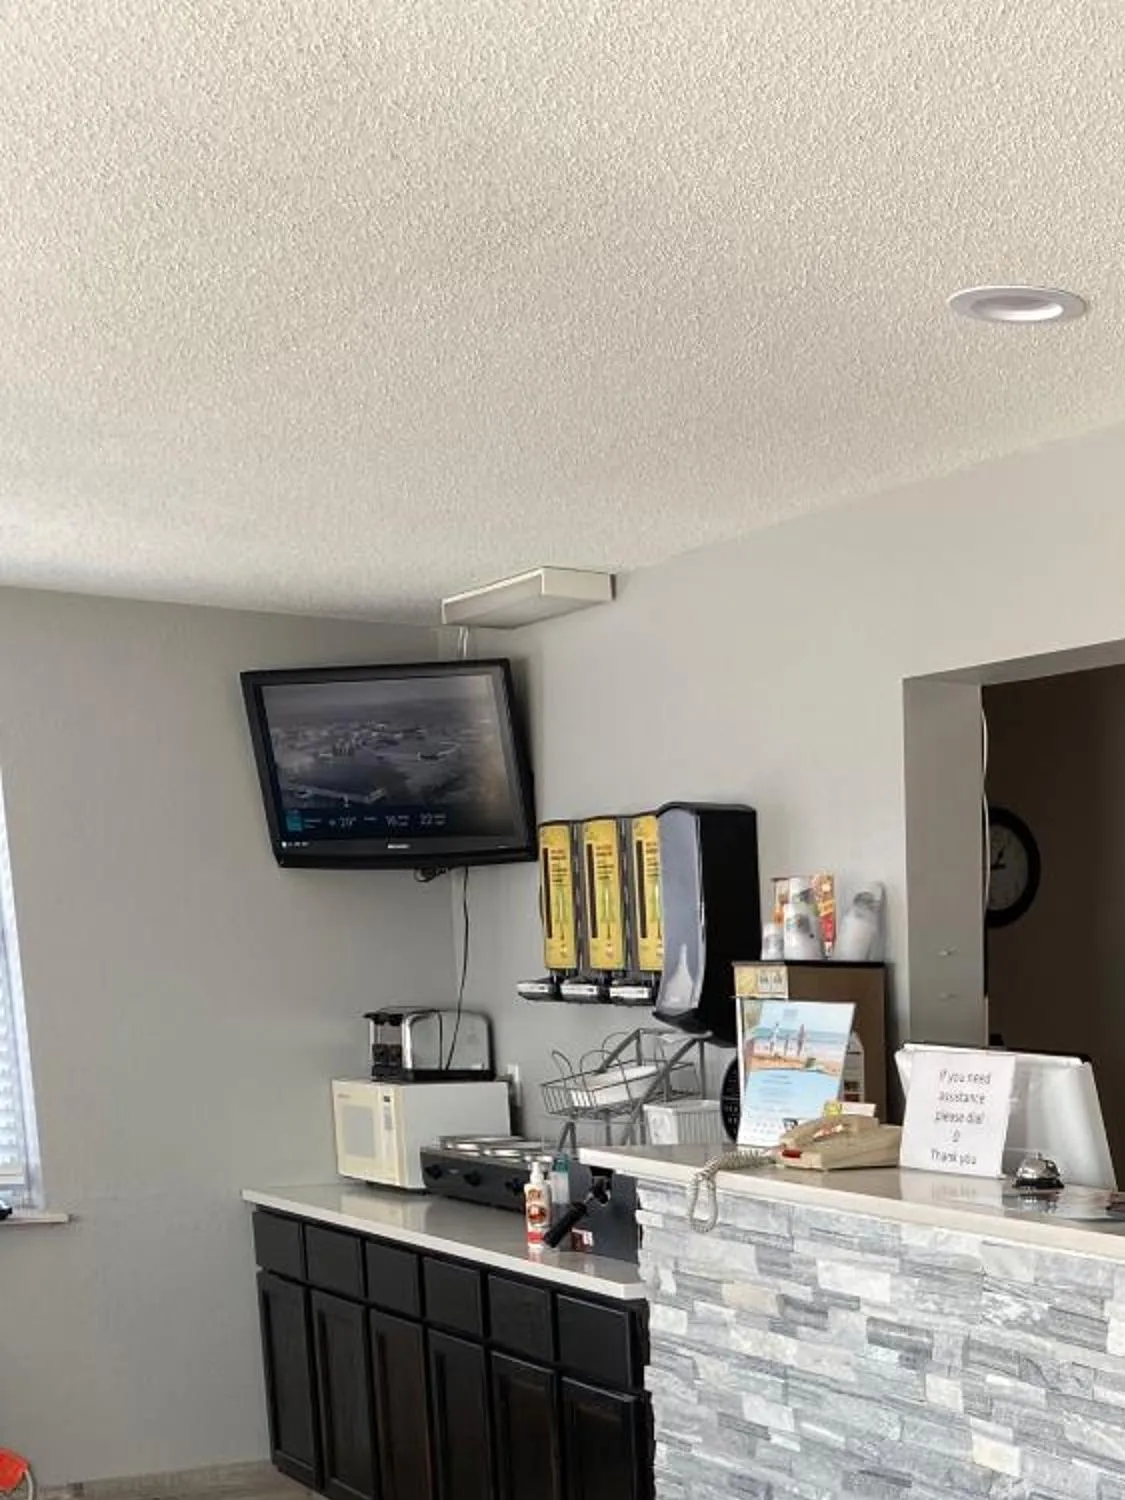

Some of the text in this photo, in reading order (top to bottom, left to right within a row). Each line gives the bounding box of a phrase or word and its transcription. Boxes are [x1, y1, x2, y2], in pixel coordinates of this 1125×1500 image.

[947, 1072, 965, 1085] you
[967, 1071, 991, 1085] need
[938, 1090, 985, 1104] assistance
[934, 1110, 985, 1124] please dial
[931, 1148, 977, 1166] Thank you
